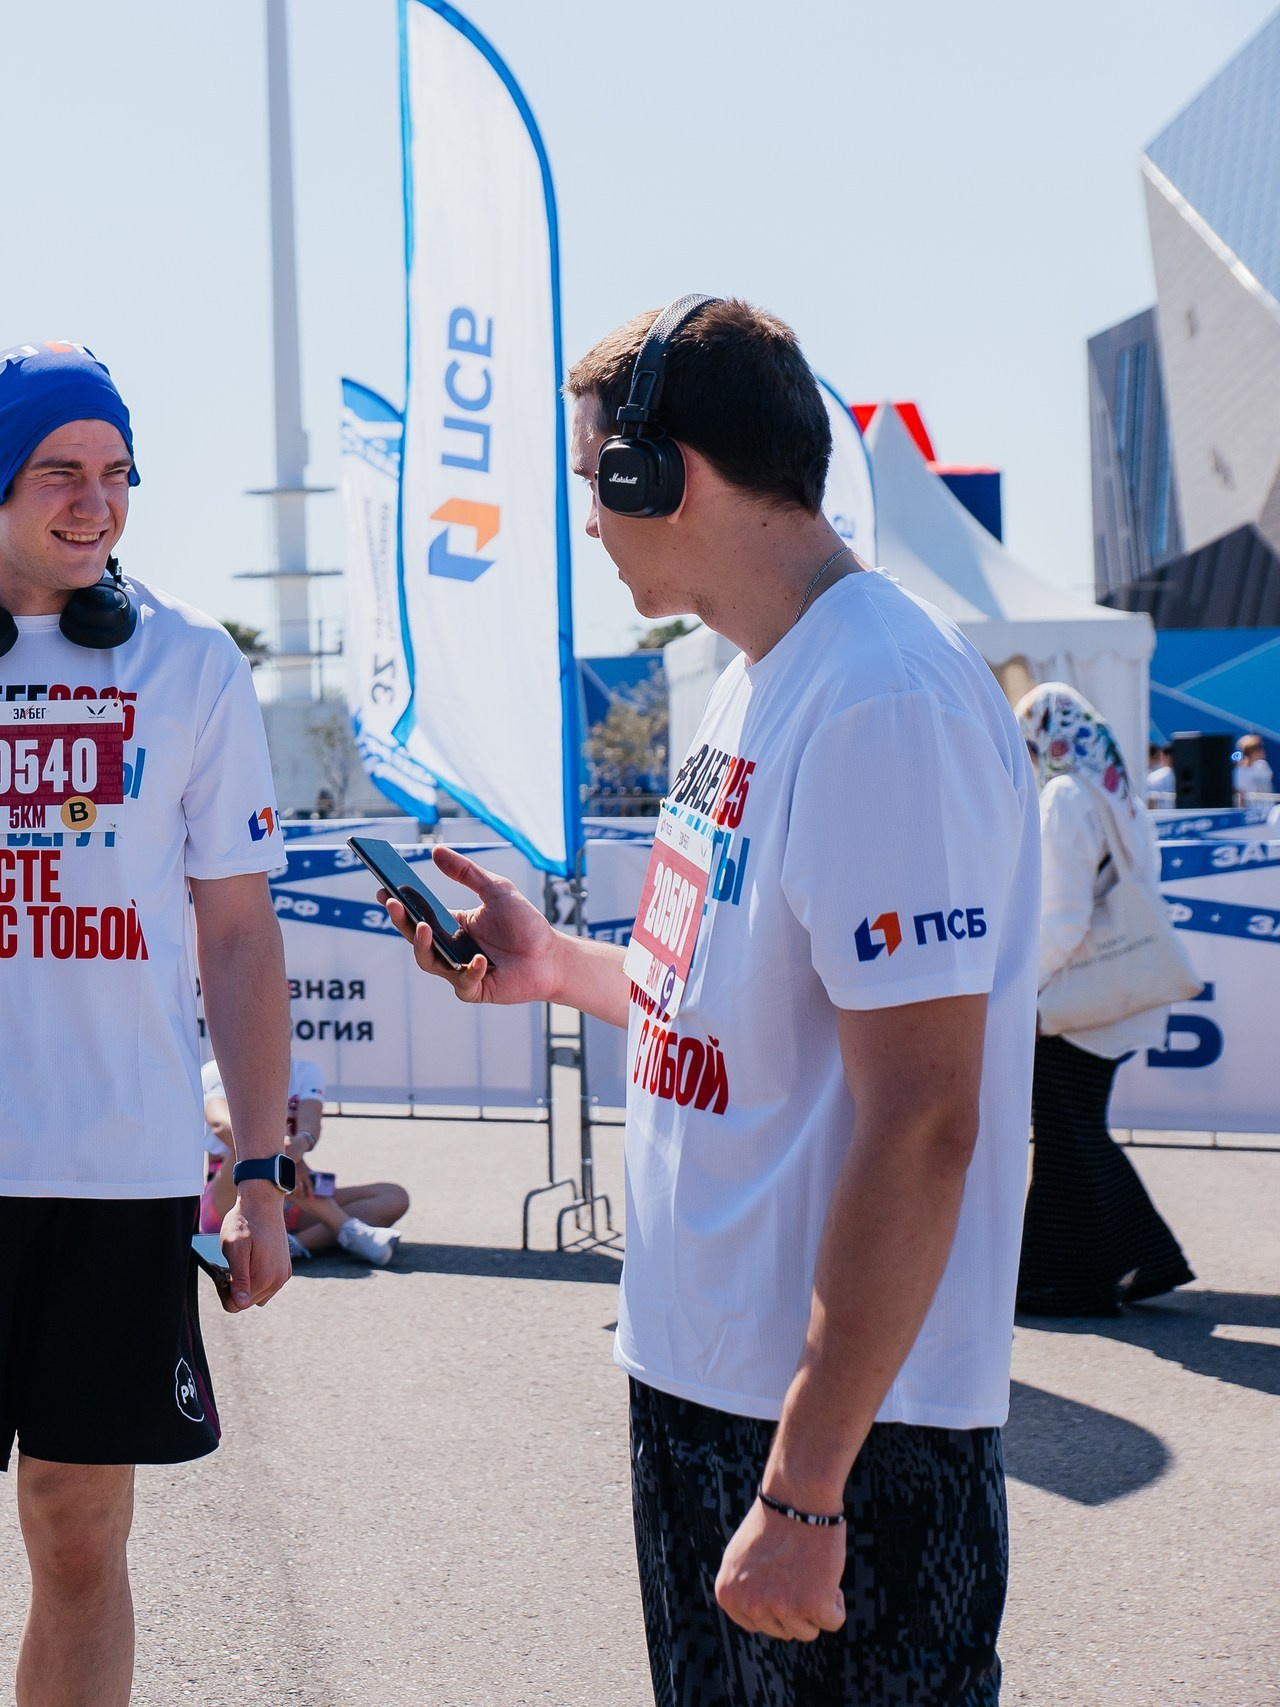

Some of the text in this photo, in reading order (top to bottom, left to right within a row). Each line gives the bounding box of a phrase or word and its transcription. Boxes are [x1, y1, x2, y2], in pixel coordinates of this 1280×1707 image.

[609, 473, 638, 484] Marshall
[26, 898, 149, 960] ТОБОЙ
[644, 861, 698, 958] 20507
[913, 907, 987, 946] ПСБ
[633, 1019, 729, 1115] С ТОБОЙ
